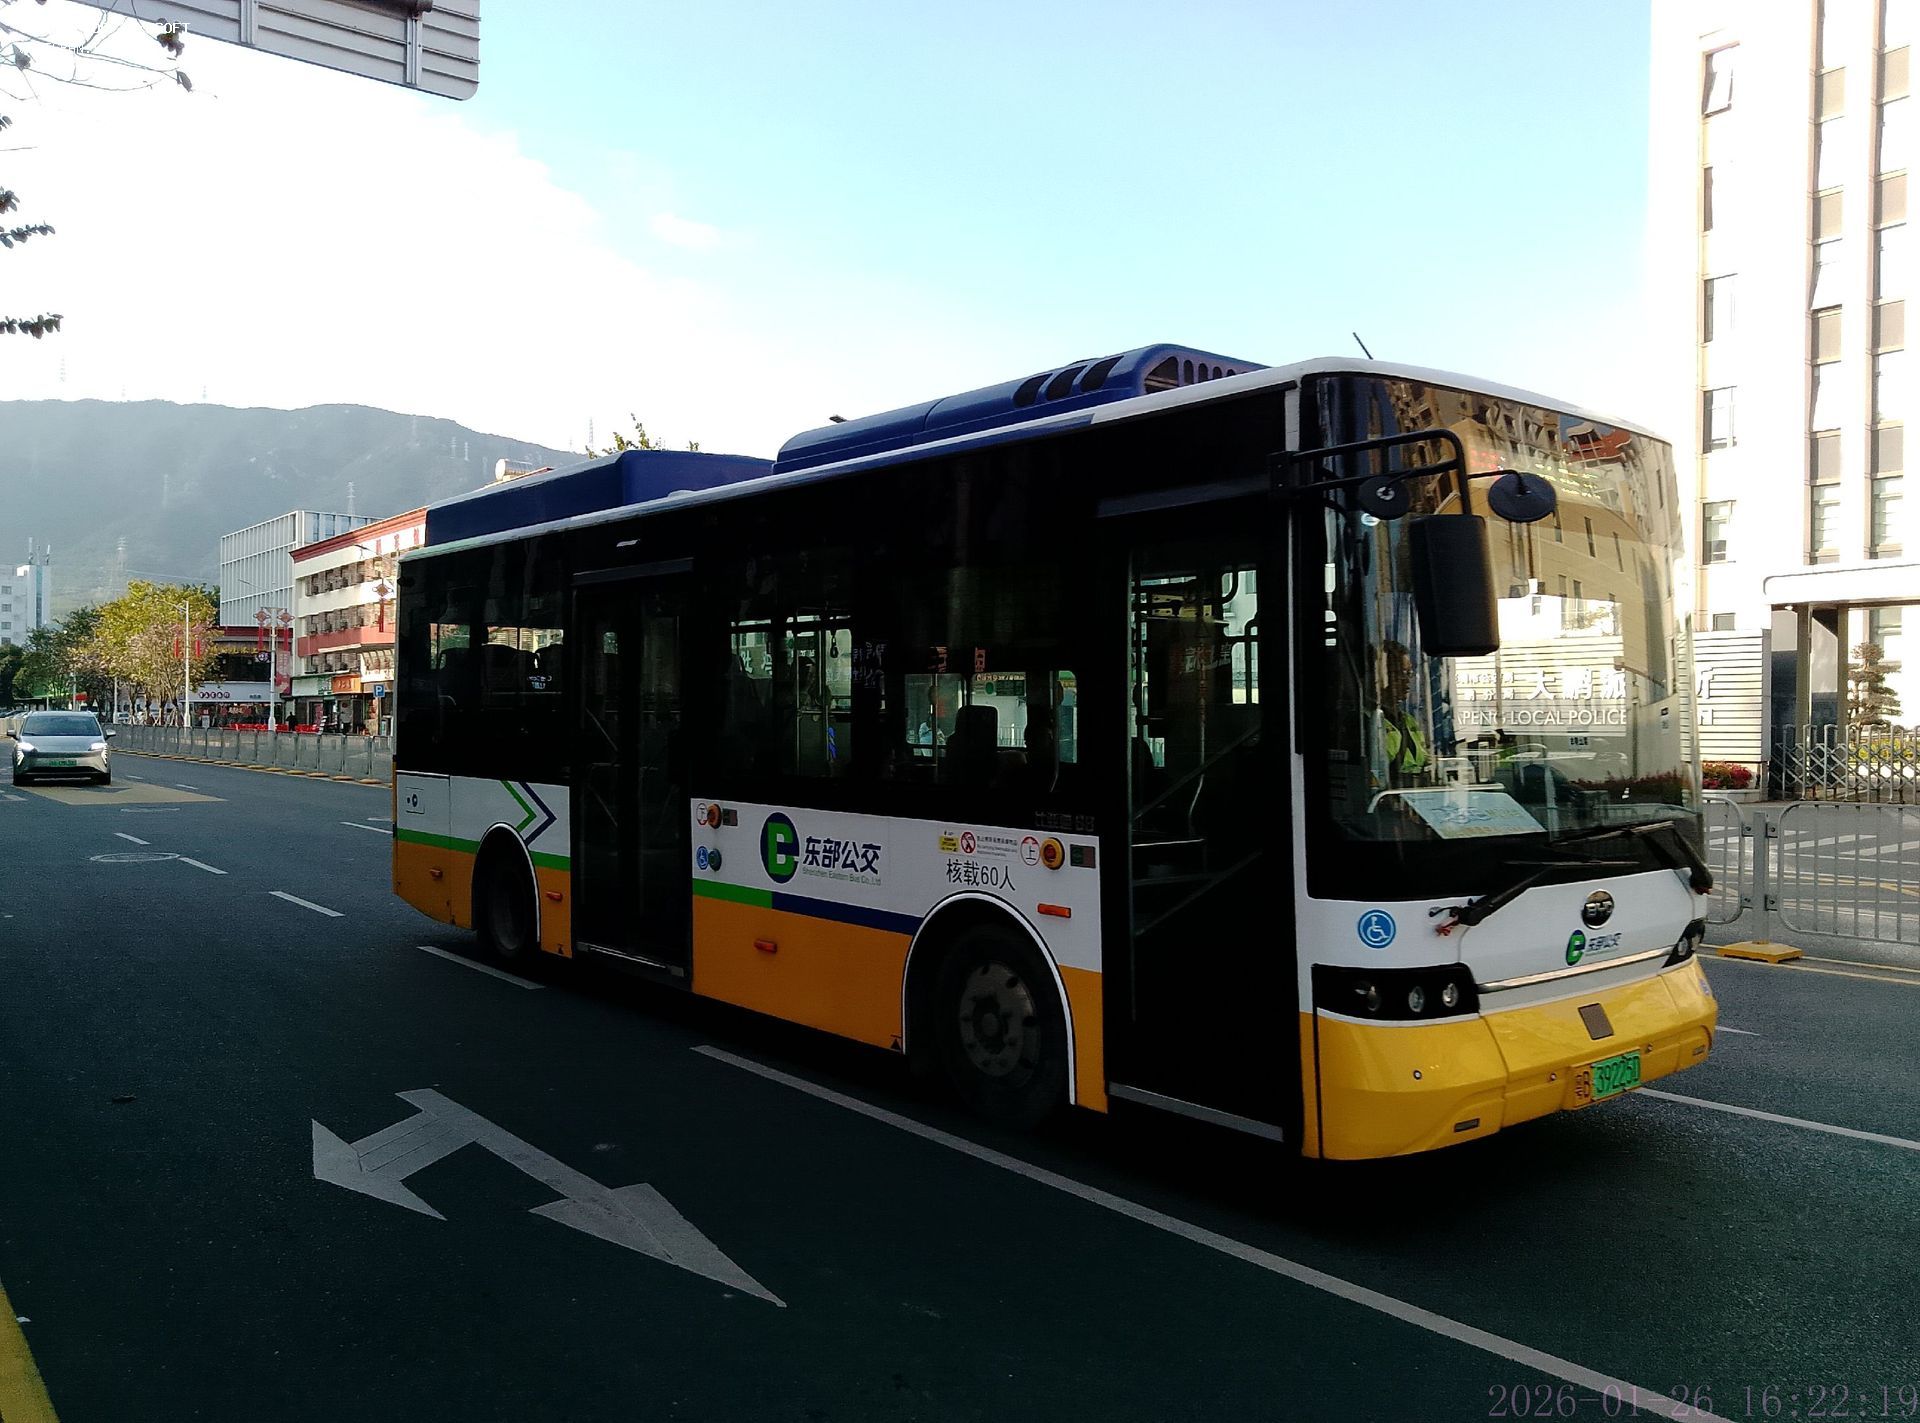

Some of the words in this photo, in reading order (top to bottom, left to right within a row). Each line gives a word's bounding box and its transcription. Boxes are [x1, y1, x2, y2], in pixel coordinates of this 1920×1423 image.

[1511, 709, 1564, 726] LOCAL
[1569, 708, 1627, 726] POLICE
[802, 835, 882, 875] 东部公交
[1025, 845, 1036, 861] 上
[946, 858, 1016, 891] 核载60人
